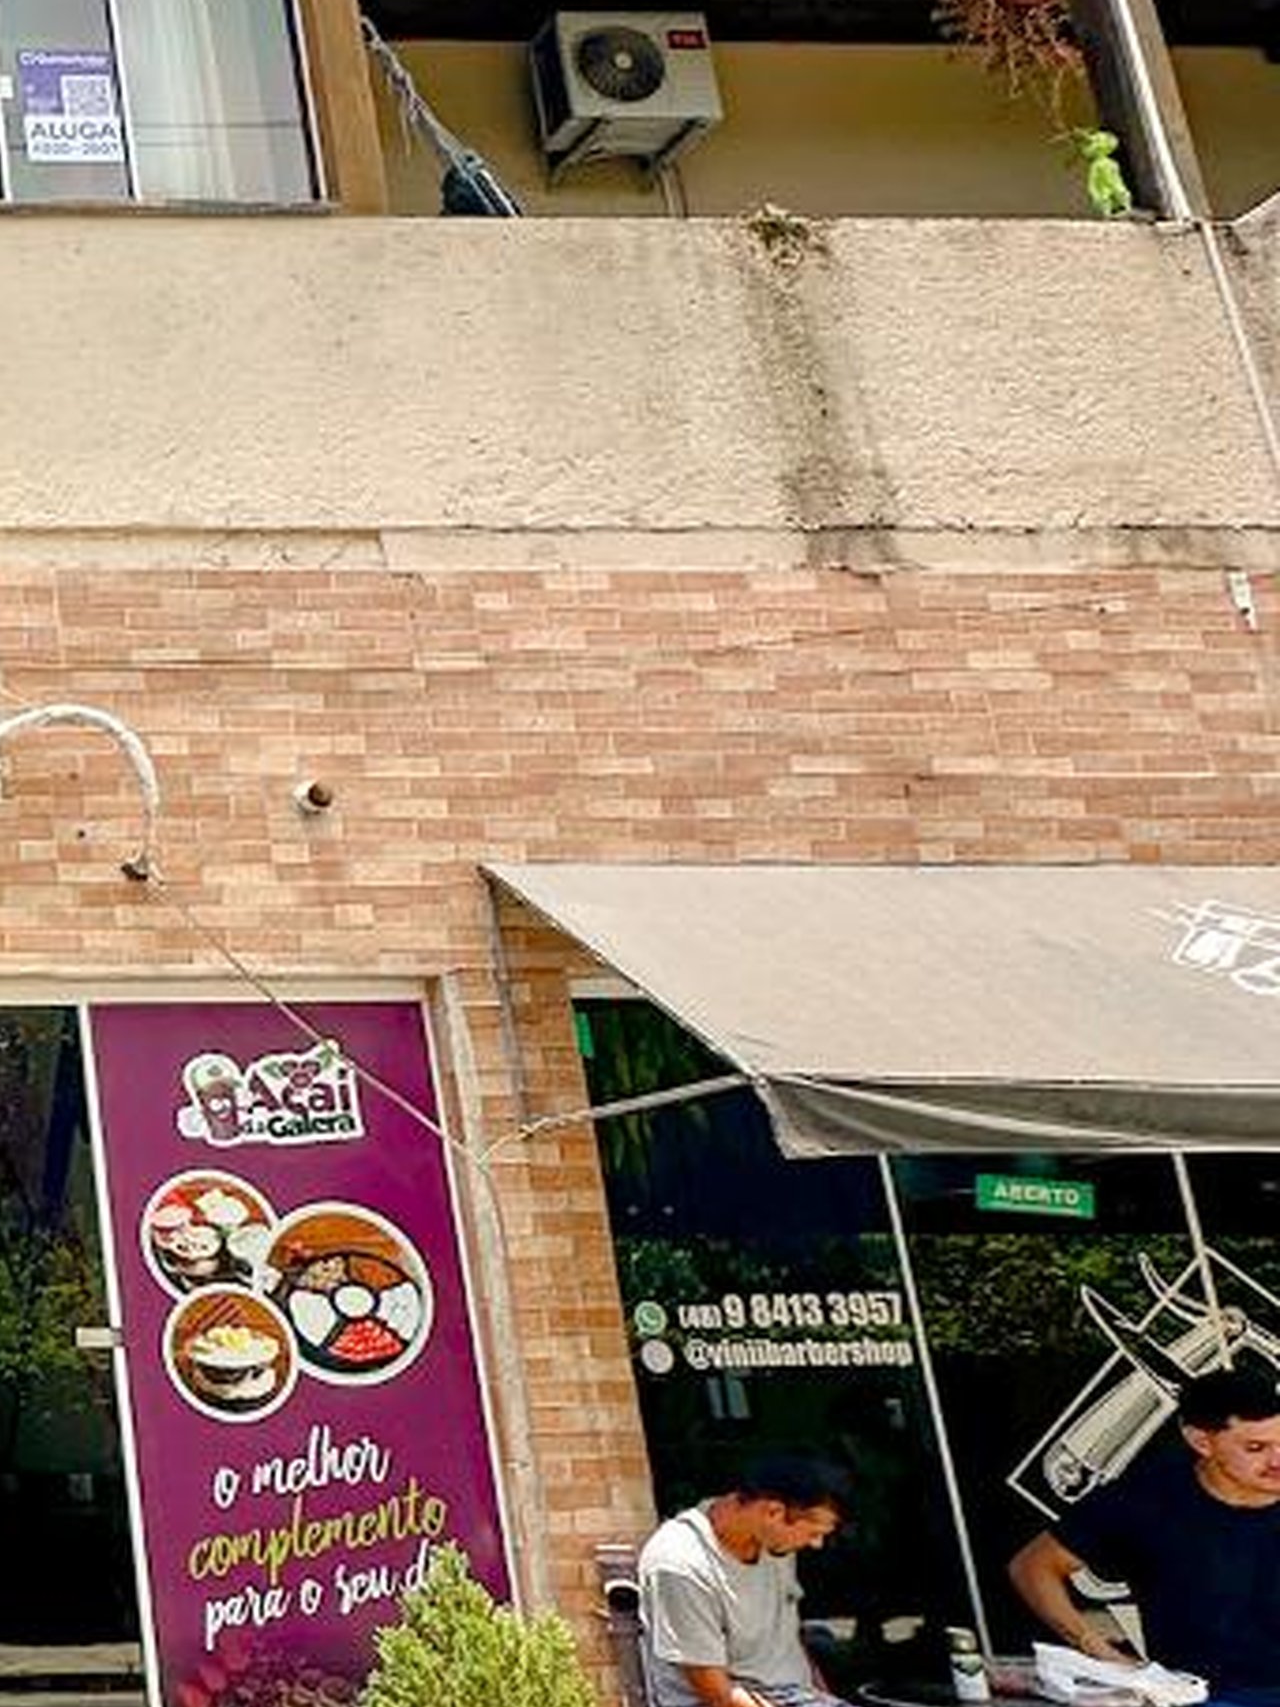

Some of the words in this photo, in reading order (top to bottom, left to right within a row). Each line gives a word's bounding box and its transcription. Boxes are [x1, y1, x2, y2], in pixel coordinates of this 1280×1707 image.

[30, 122, 118, 140] ALUGA
[723, 1293, 745, 1328] 9
[750, 1292, 823, 1328] 8413
[828, 1291, 901, 1327] 3957
[213, 1467, 239, 1508] o
[252, 1424, 391, 1494] melhor
[189, 1476, 447, 1586] complemento
[205, 1585, 290, 1651] para
[300, 1578, 323, 1615] o
[335, 1563, 398, 1615] seu
